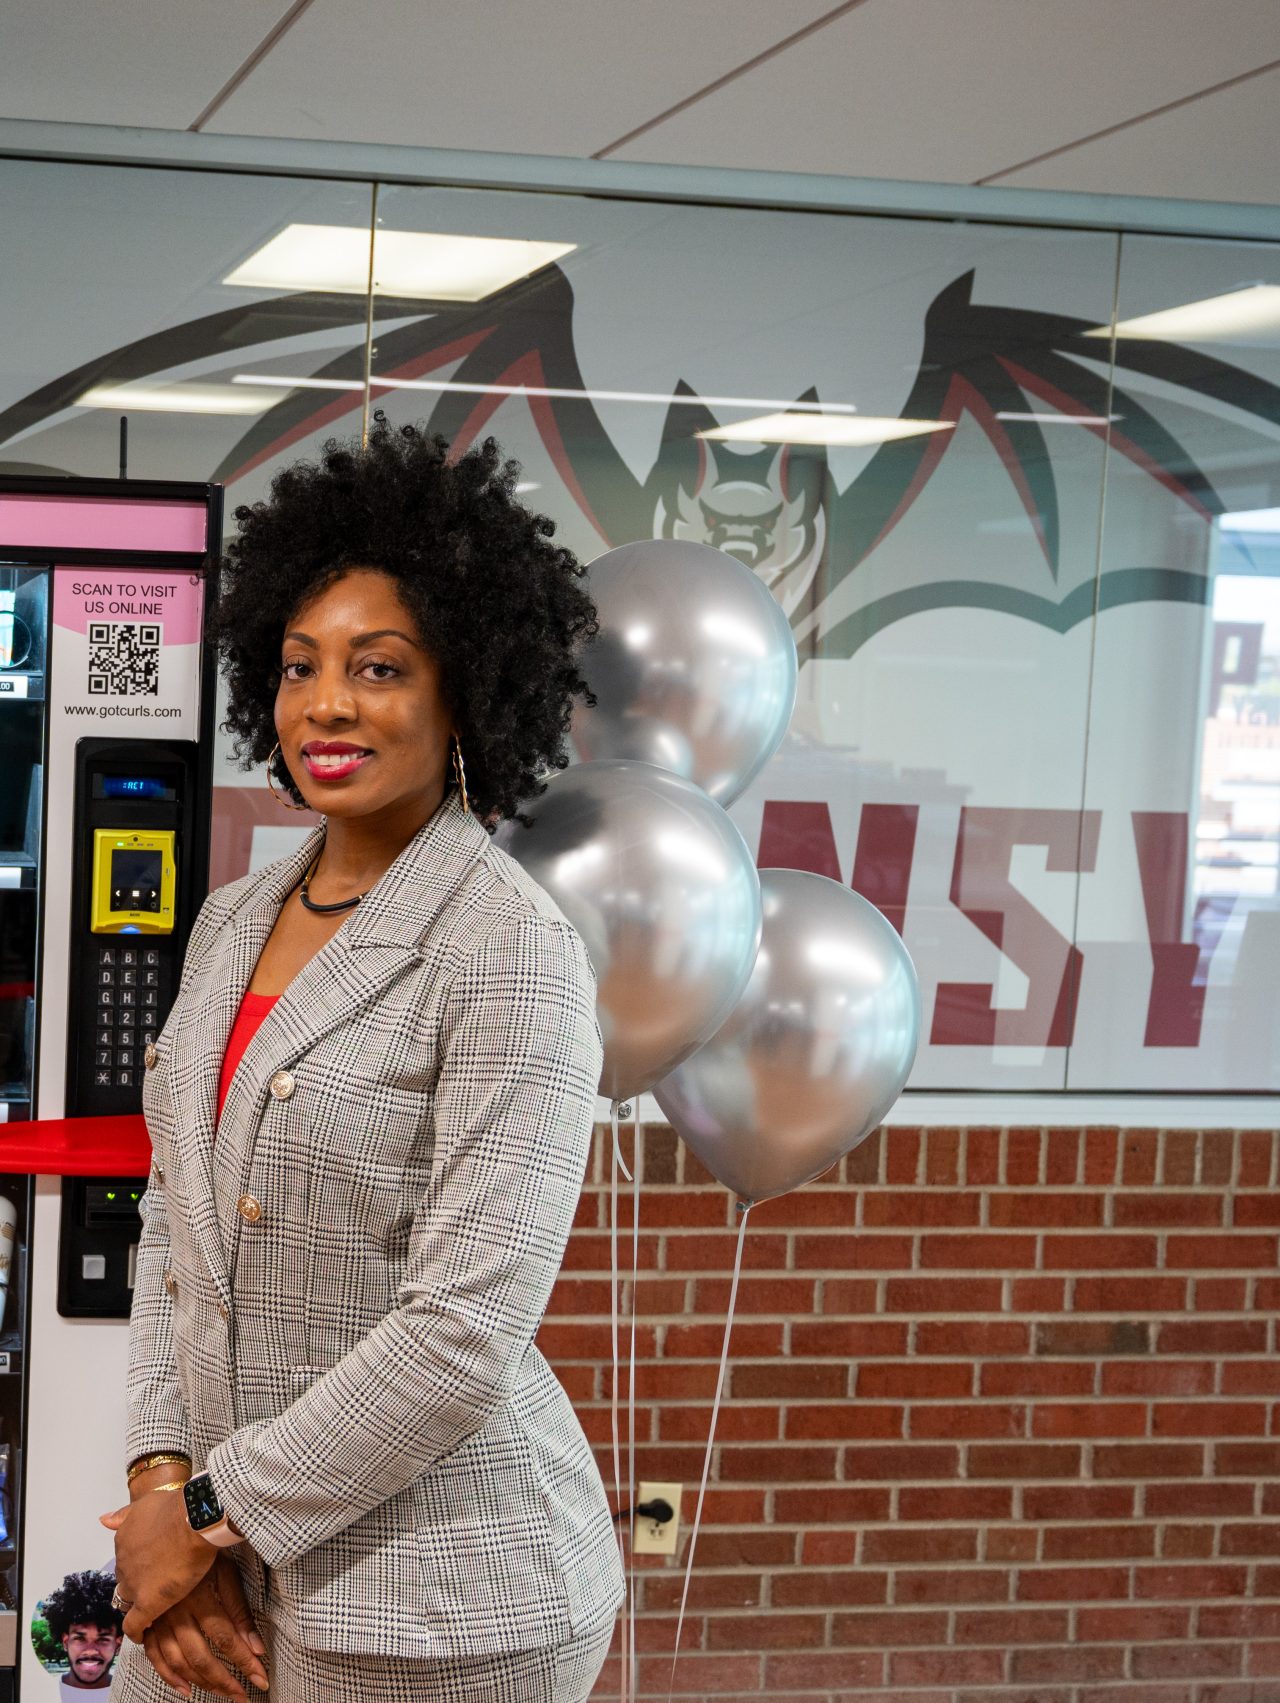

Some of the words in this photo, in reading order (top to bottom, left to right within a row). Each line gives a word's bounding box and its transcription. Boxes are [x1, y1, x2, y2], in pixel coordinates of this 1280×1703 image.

[72, 583, 113, 596] SCAN
[117, 584, 137, 597] TO
[141, 585, 177, 598] VISIT
[84, 601, 105, 614] US
[109, 602, 163, 615] ONLINE
[64, 705, 182, 718] www.gotcurls.com
[104, 953, 111, 963] A
[125, 953, 132, 963] B
[147, 954, 154, 964] C
[103, 973, 110, 983] D
[124, 973, 131, 983] E
[147, 973, 154, 983] F
[102, 993, 110, 1003] G
[123, 993, 131, 1003] H
[146, 994, 152, 1004] J
[102, 1013, 107, 1023] 1
[123, 1013, 130, 1023] 2
[145, 1013, 152, 1024] 3
[101, 1033, 108, 1043] 4
[122, 1033, 129, 1043] 5
[144, 1033, 151, 1044] 6
[100, 1053, 107, 1063] 7
[122, 1053, 128, 1063] 8
[121, 1073, 128, 1083] 0
